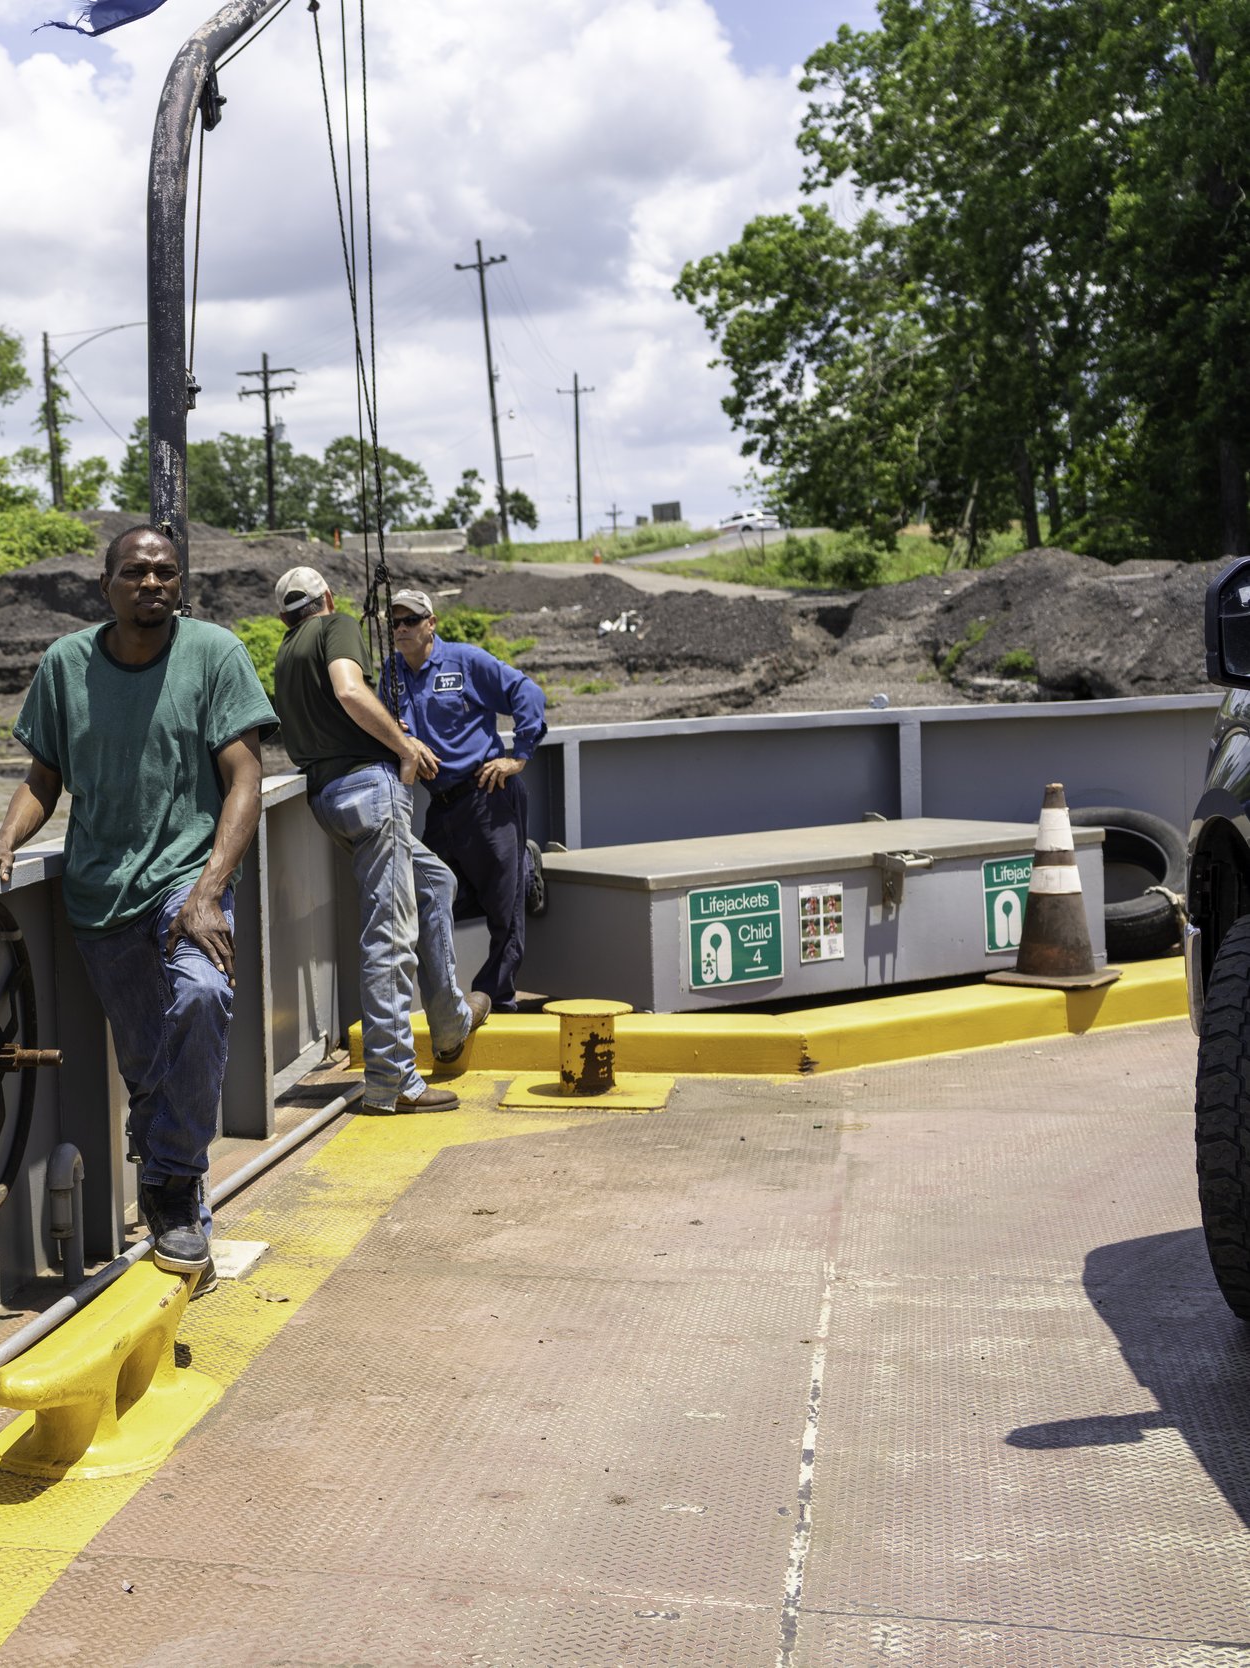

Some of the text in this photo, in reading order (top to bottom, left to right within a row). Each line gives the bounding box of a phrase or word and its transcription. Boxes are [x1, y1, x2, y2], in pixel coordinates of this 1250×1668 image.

[700, 893, 770, 916] Lifejackets
[738, 922, 773, 942] Child
[752, 949, 763, 964] 4
